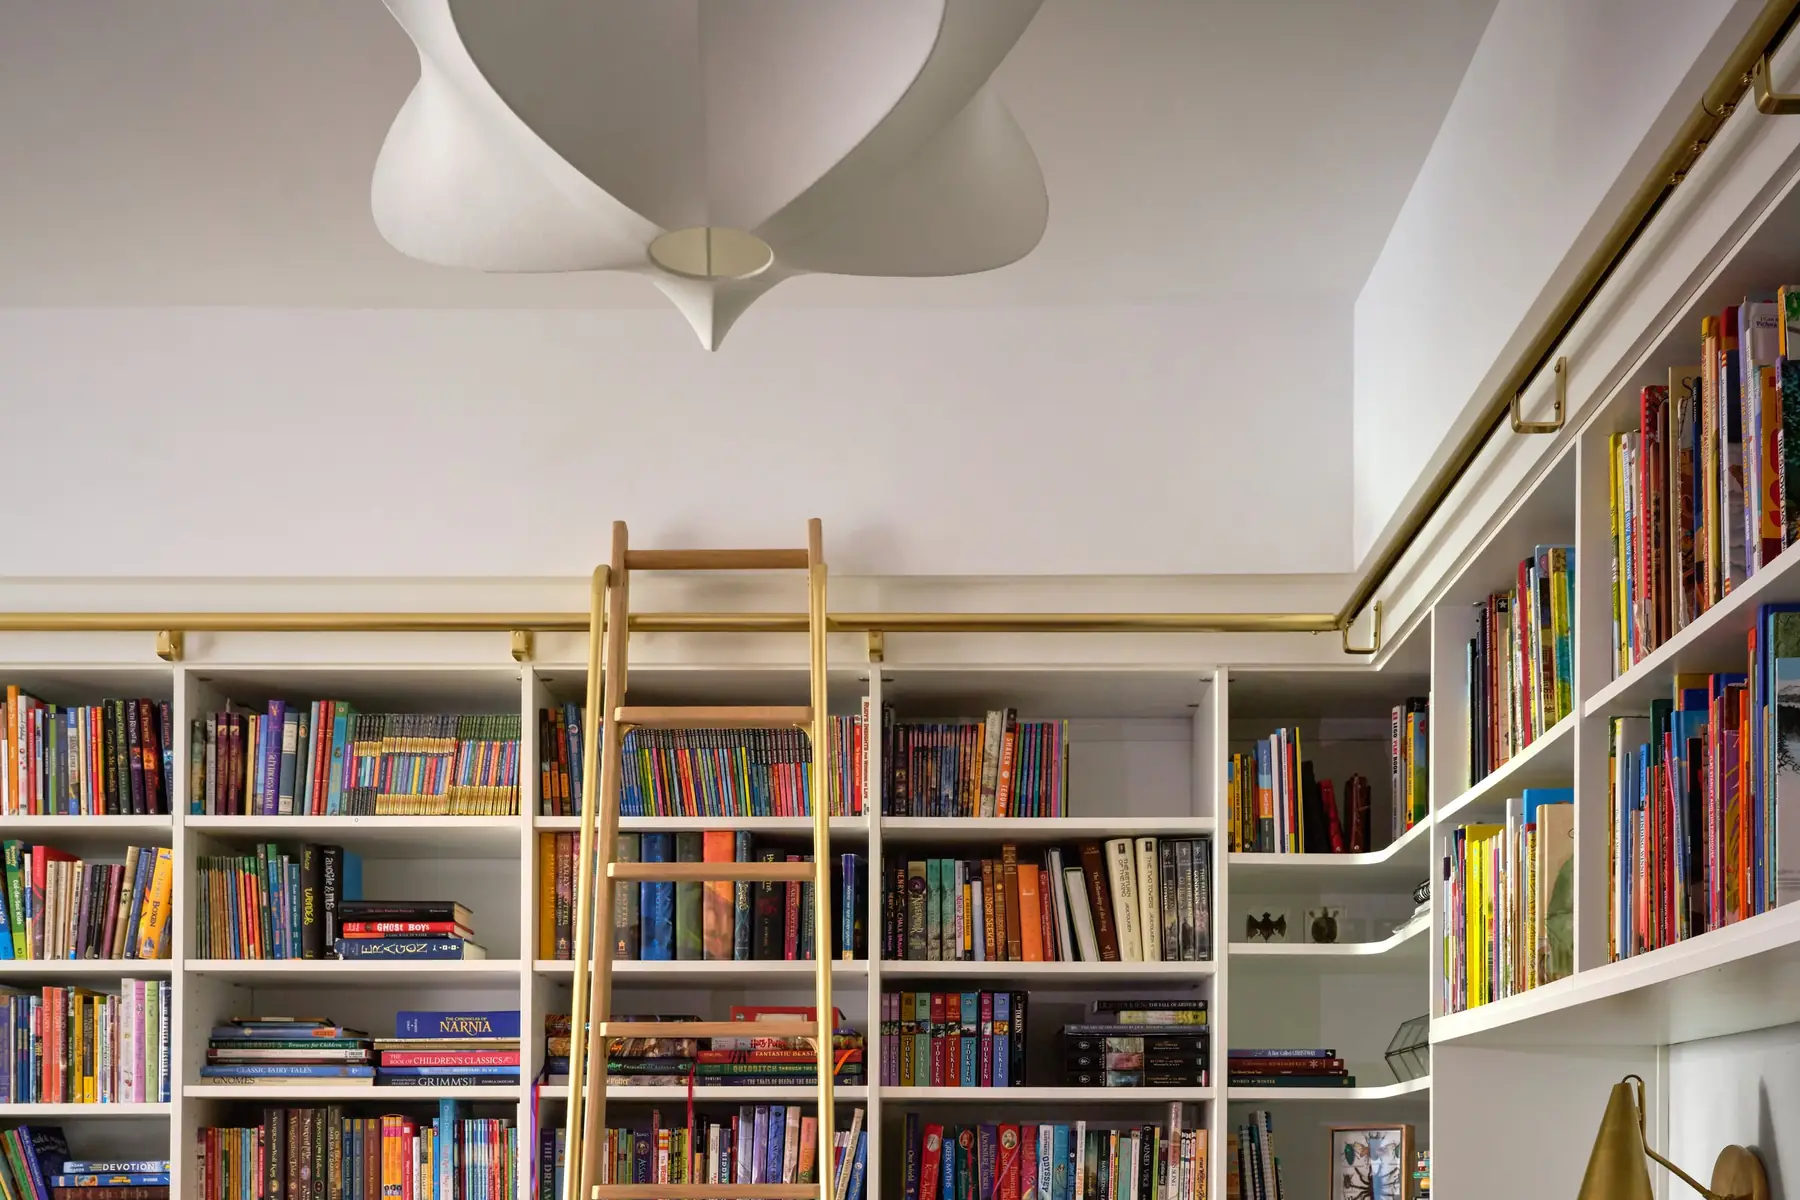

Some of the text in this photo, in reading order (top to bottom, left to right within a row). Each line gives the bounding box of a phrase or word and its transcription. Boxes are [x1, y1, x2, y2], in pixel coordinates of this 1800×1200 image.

[1623, 450, 1631, 480] Richard
[999, 737, 1012, 808] SHAKEN TEBOW
[12, 879, 20, 910] Cul-de-Sac
[304, 887, 313, 925] WONDER
[150, 901, 160, 928] BOXEN
[376, 923, 430, 932] GHOST BOYS
[909, 894, 924, 934] NEVERMOOR
[985, 895, 994, 947] STORY SEEKER
[361, 943, 428, 954] ERAGON
[440, 1021, 492, 1036] NARNIA
[464, 1056, 503, 1064] CLASSICS
[418, 1077, 468, 1086] GRIMM'S
[544, 1140, 552, 1160] THE
[981, 1131, 989, 1165] ADVENTURE
[102, 1163, 156, 1171] DEVOTION
[1041, 1156, 1052, 1192] ODYSSEY
